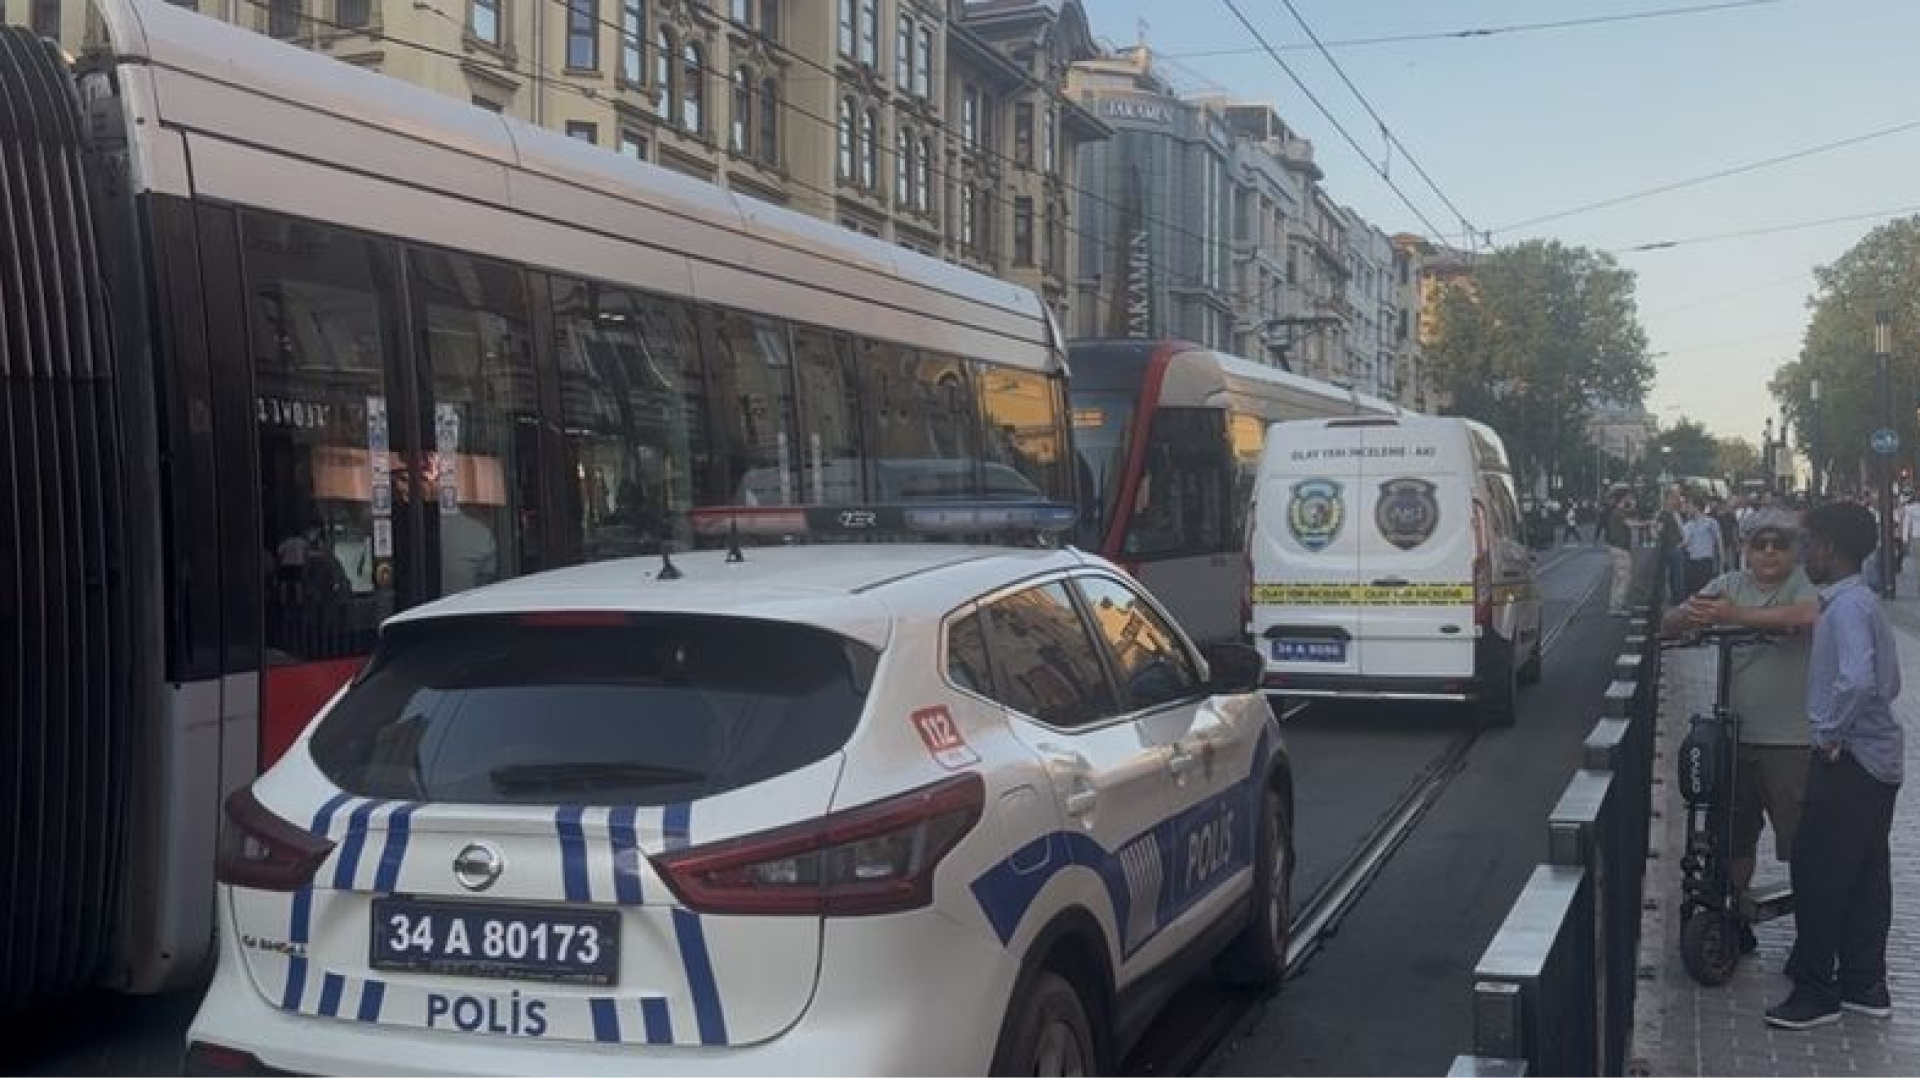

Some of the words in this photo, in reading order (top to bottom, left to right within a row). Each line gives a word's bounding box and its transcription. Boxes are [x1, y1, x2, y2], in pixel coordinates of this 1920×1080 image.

[921, 714, 957, 748] 112
[389, 915, 433, 954] 34
[445, 919, 470, 955] A
[483, 921, 600, 963] 80173
[427, 990, 547, 1037] POLİS
